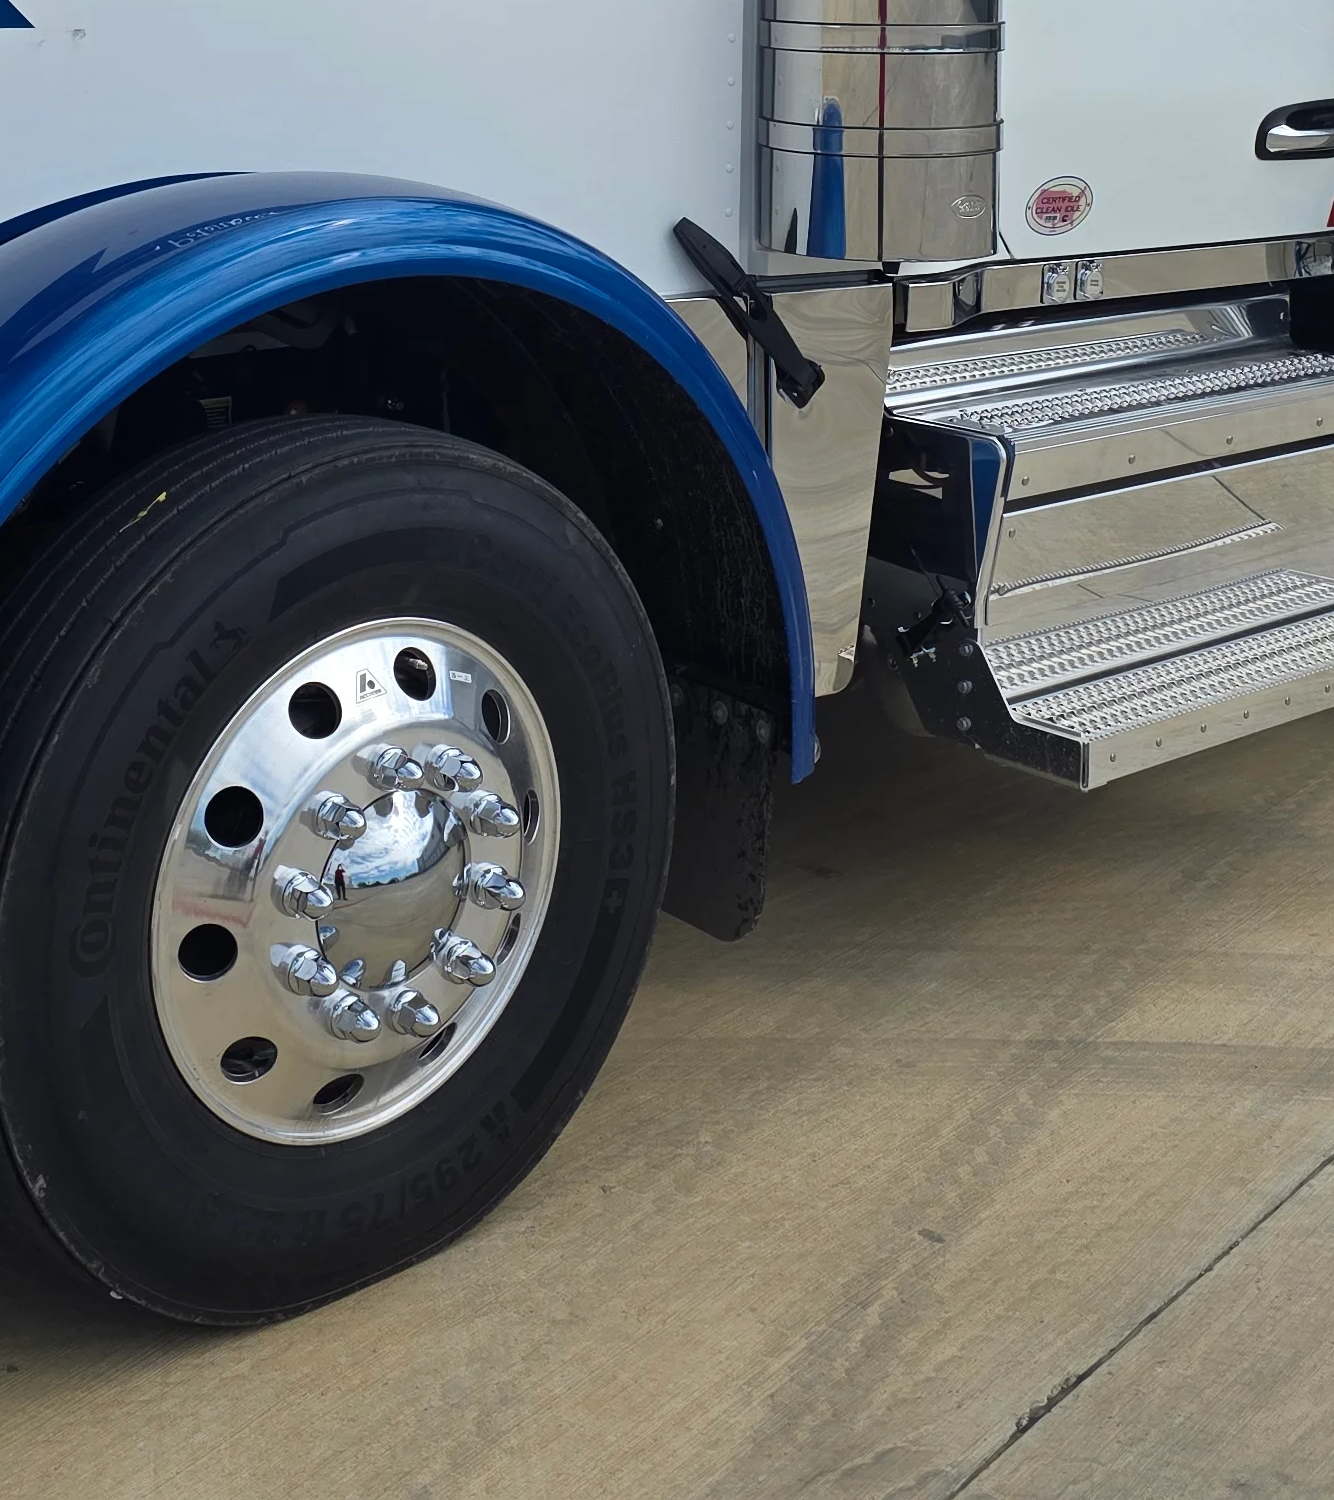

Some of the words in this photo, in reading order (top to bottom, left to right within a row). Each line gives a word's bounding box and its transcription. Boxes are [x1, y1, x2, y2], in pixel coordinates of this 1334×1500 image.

[1035, 206, 1061, 214] CLEAN
[1065, 205, 1082, 213] IDLE
[1041, 195, 1081, 205] CERTIFIED
[69, 649, 216, 978] Continental
[338, 1134, 484, 1241] 295/75
